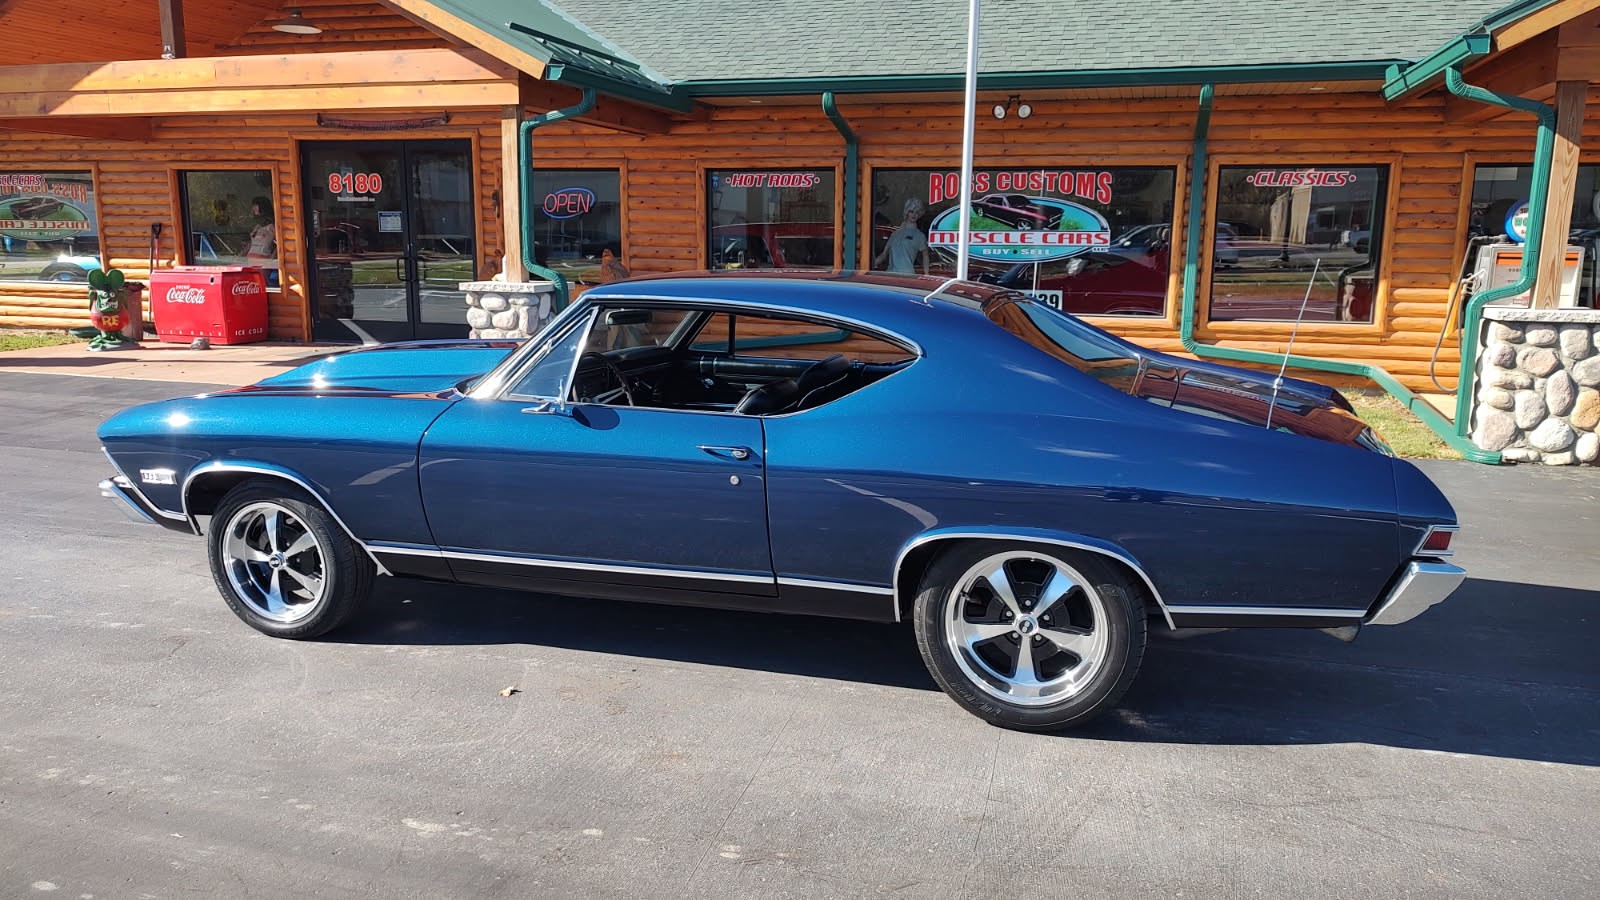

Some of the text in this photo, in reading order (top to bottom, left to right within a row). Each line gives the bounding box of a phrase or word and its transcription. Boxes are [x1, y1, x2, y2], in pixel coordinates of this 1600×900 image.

[329, 173, 382, 193] 8180
[731, 174, 815, 187] HOT RODS
[1254, 171, 1349, 186] CLASSICS
[929, 171, 1112, 205] ROS CUSTOMS
[544, 193, 590, 212] OPEN
[1042, 232, 1109, 245] CARS
